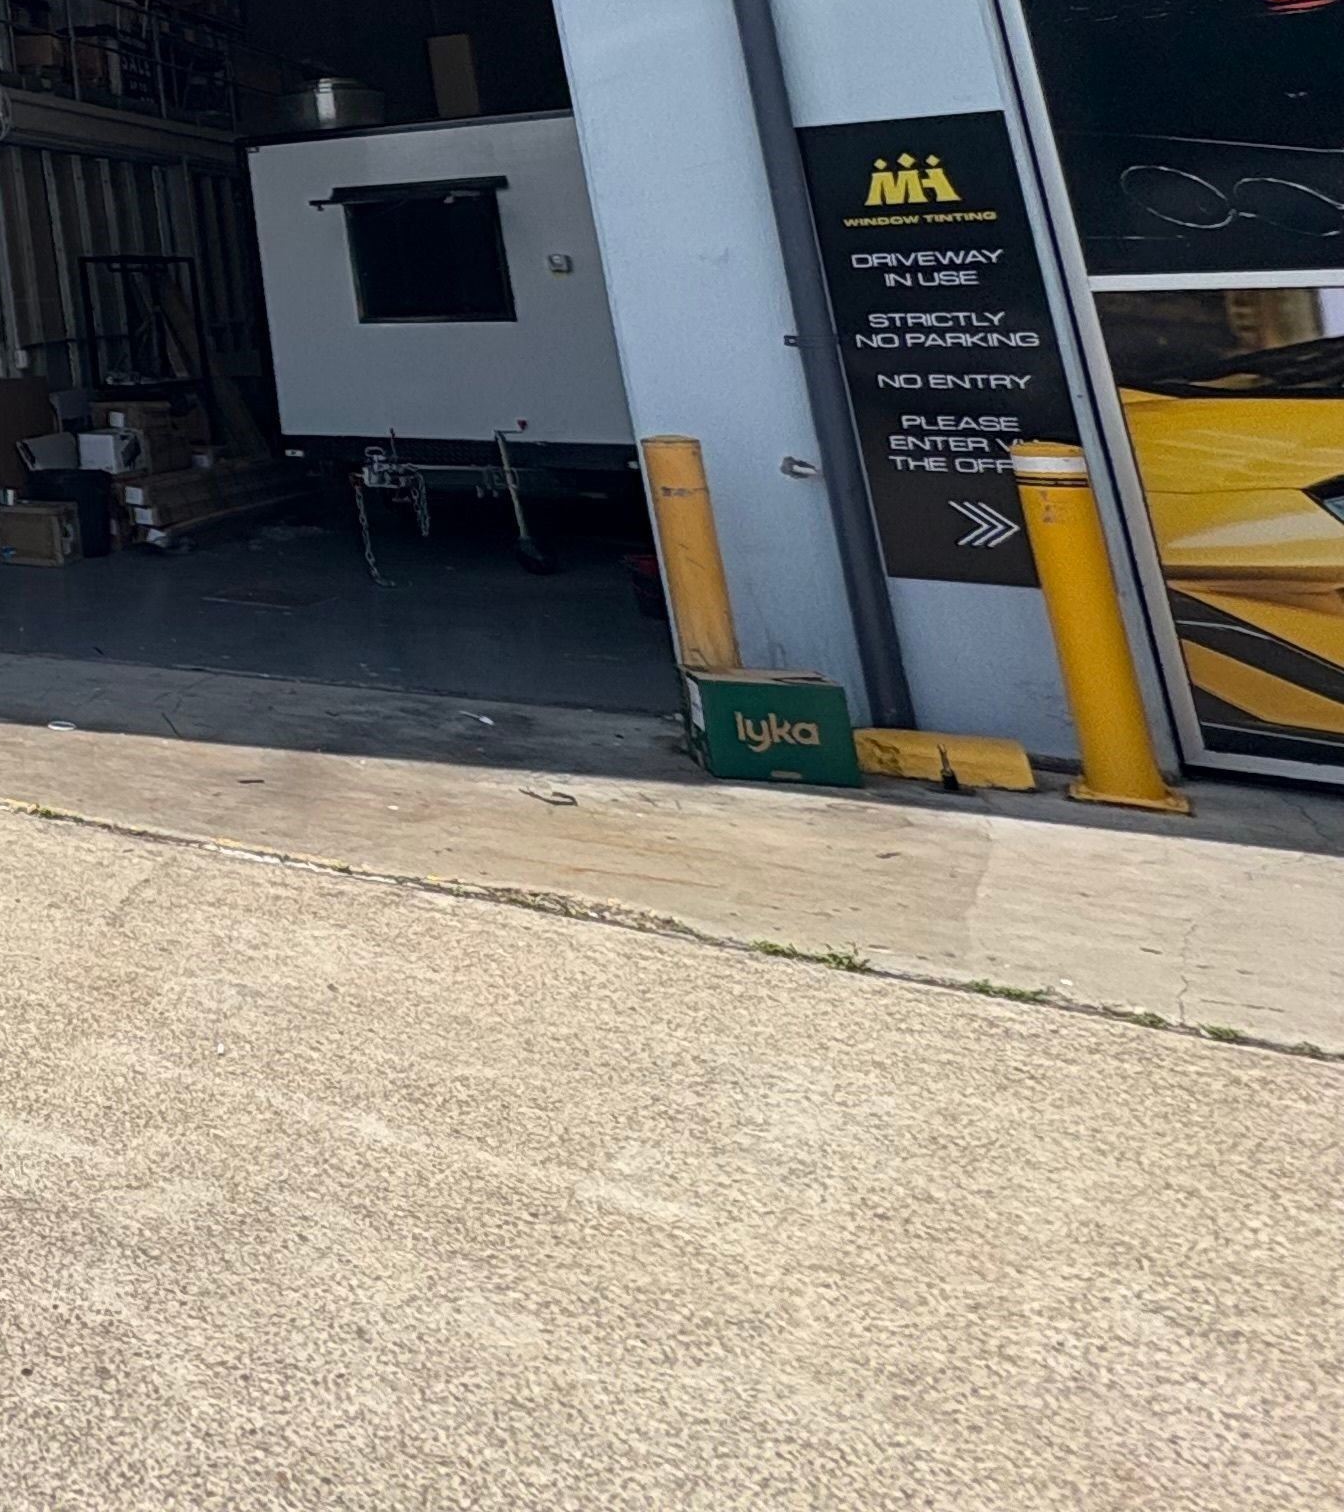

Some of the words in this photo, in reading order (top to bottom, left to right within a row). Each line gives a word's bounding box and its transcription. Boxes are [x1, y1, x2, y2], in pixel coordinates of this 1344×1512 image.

[843, 214, 920, 228] WINDOW
[923, 210, 997, 224] TINTING
[851, 249, 1003, 268] DRIVEWAY
[884, 272, 912, 287] IN
[918, 270, 980, 286] USE
[868, 311, 1005, 328] STRICTLY
[855, 333, 900, 348] NO
[905, 332, 1041, 348] PARKING
[877, 374, 923, 389] NO
[928, 374, 1032, 389] ENTRY
[901, 415, 1021, 432] PLEASE
[888, 435, 990, 452] ENTER
[888, 455, 949, 472] THE
[955, 458, 1014, 474] OFF
[734, 711, 821, 752] lyka
